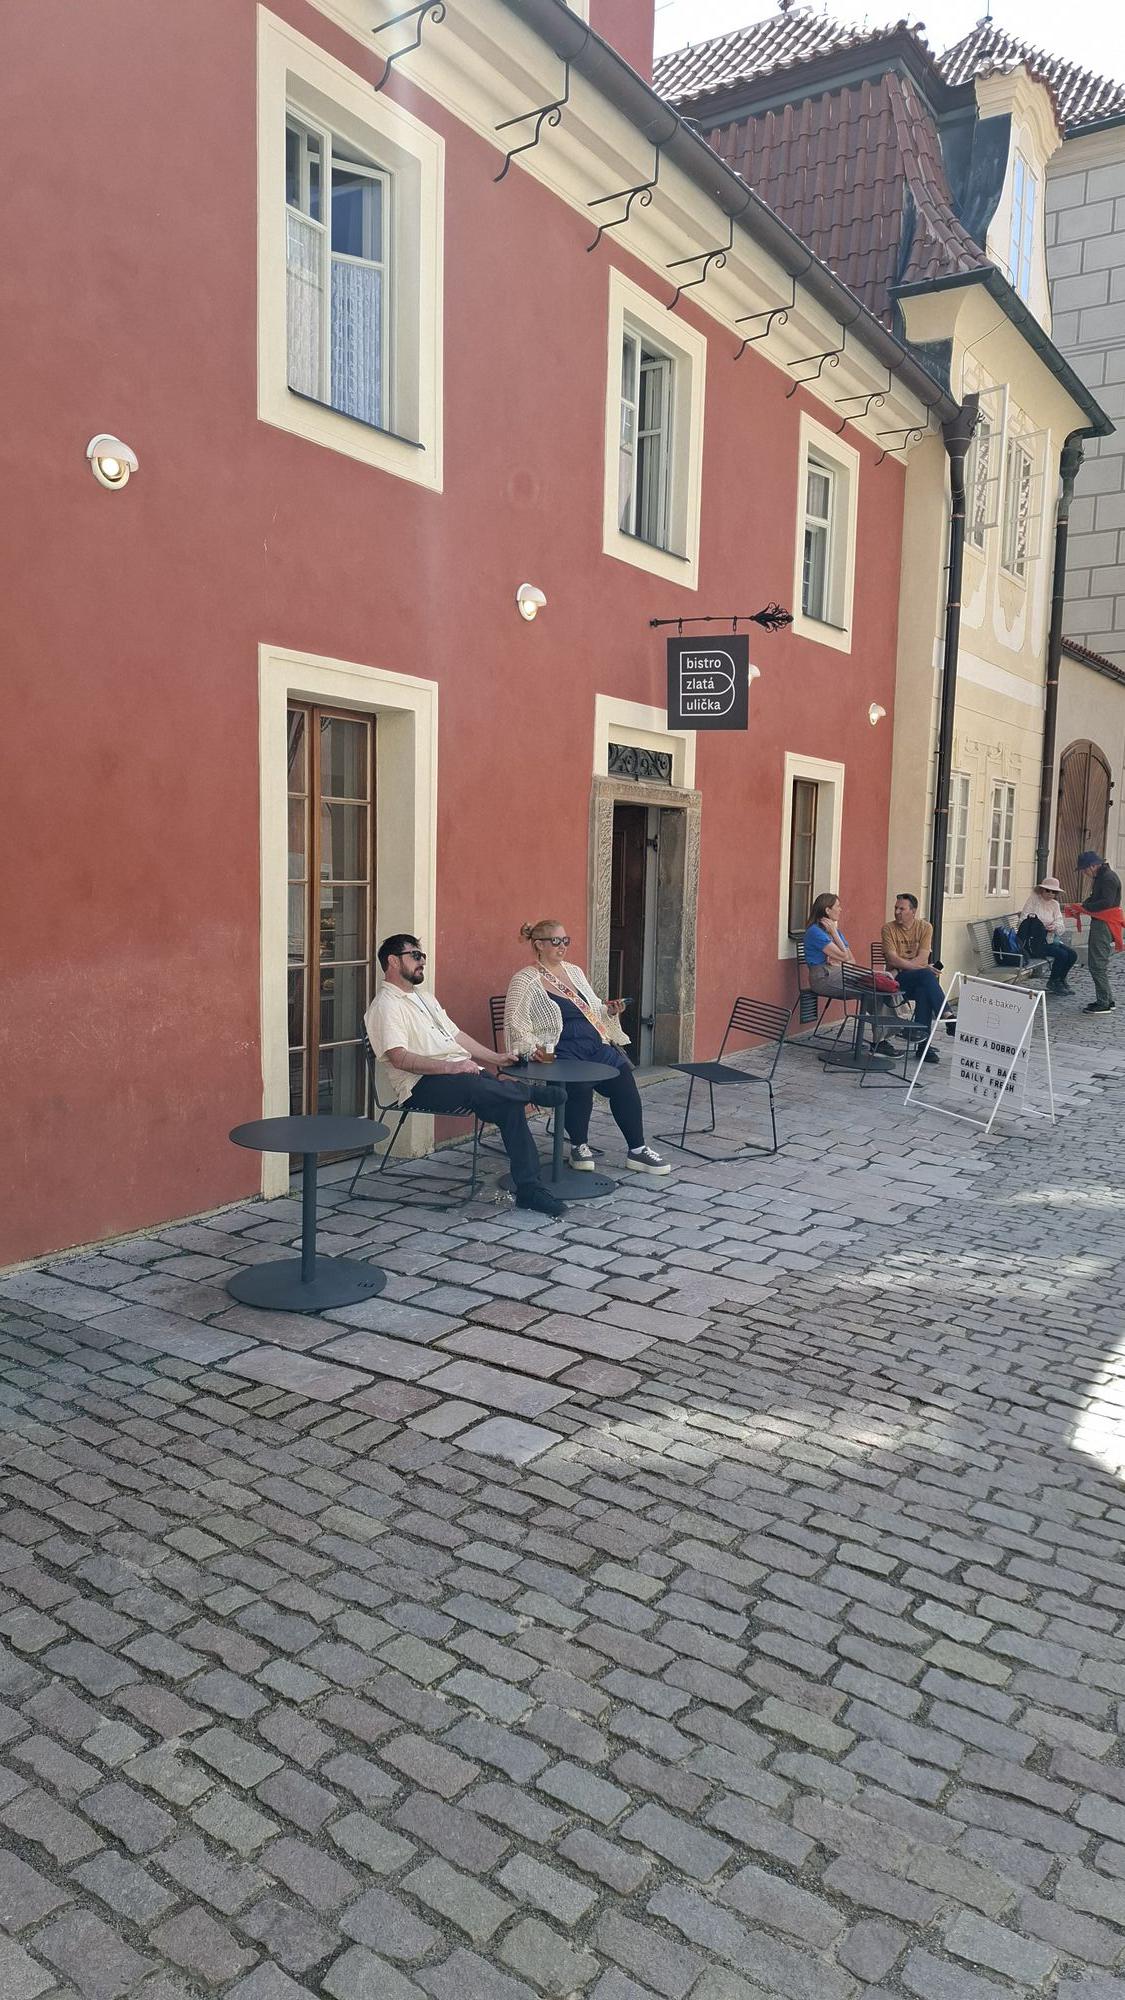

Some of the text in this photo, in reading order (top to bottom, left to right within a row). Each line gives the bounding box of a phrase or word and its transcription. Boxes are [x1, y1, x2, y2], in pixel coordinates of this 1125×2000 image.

[686, 657, 722, 669] bistro
[686, 677, 714, 690] zlatá
[686, 698, 721, 710] ulička
[970, 994, 1022, 1014] cafe & bakery
[960, 1033, 1027, 1058] KAFE A DOBROY
[960, 1058, 980, 1070] CAKE
[986, 1065, 991, 1074] &
[960, 1070, 984, 1083] DAILY
